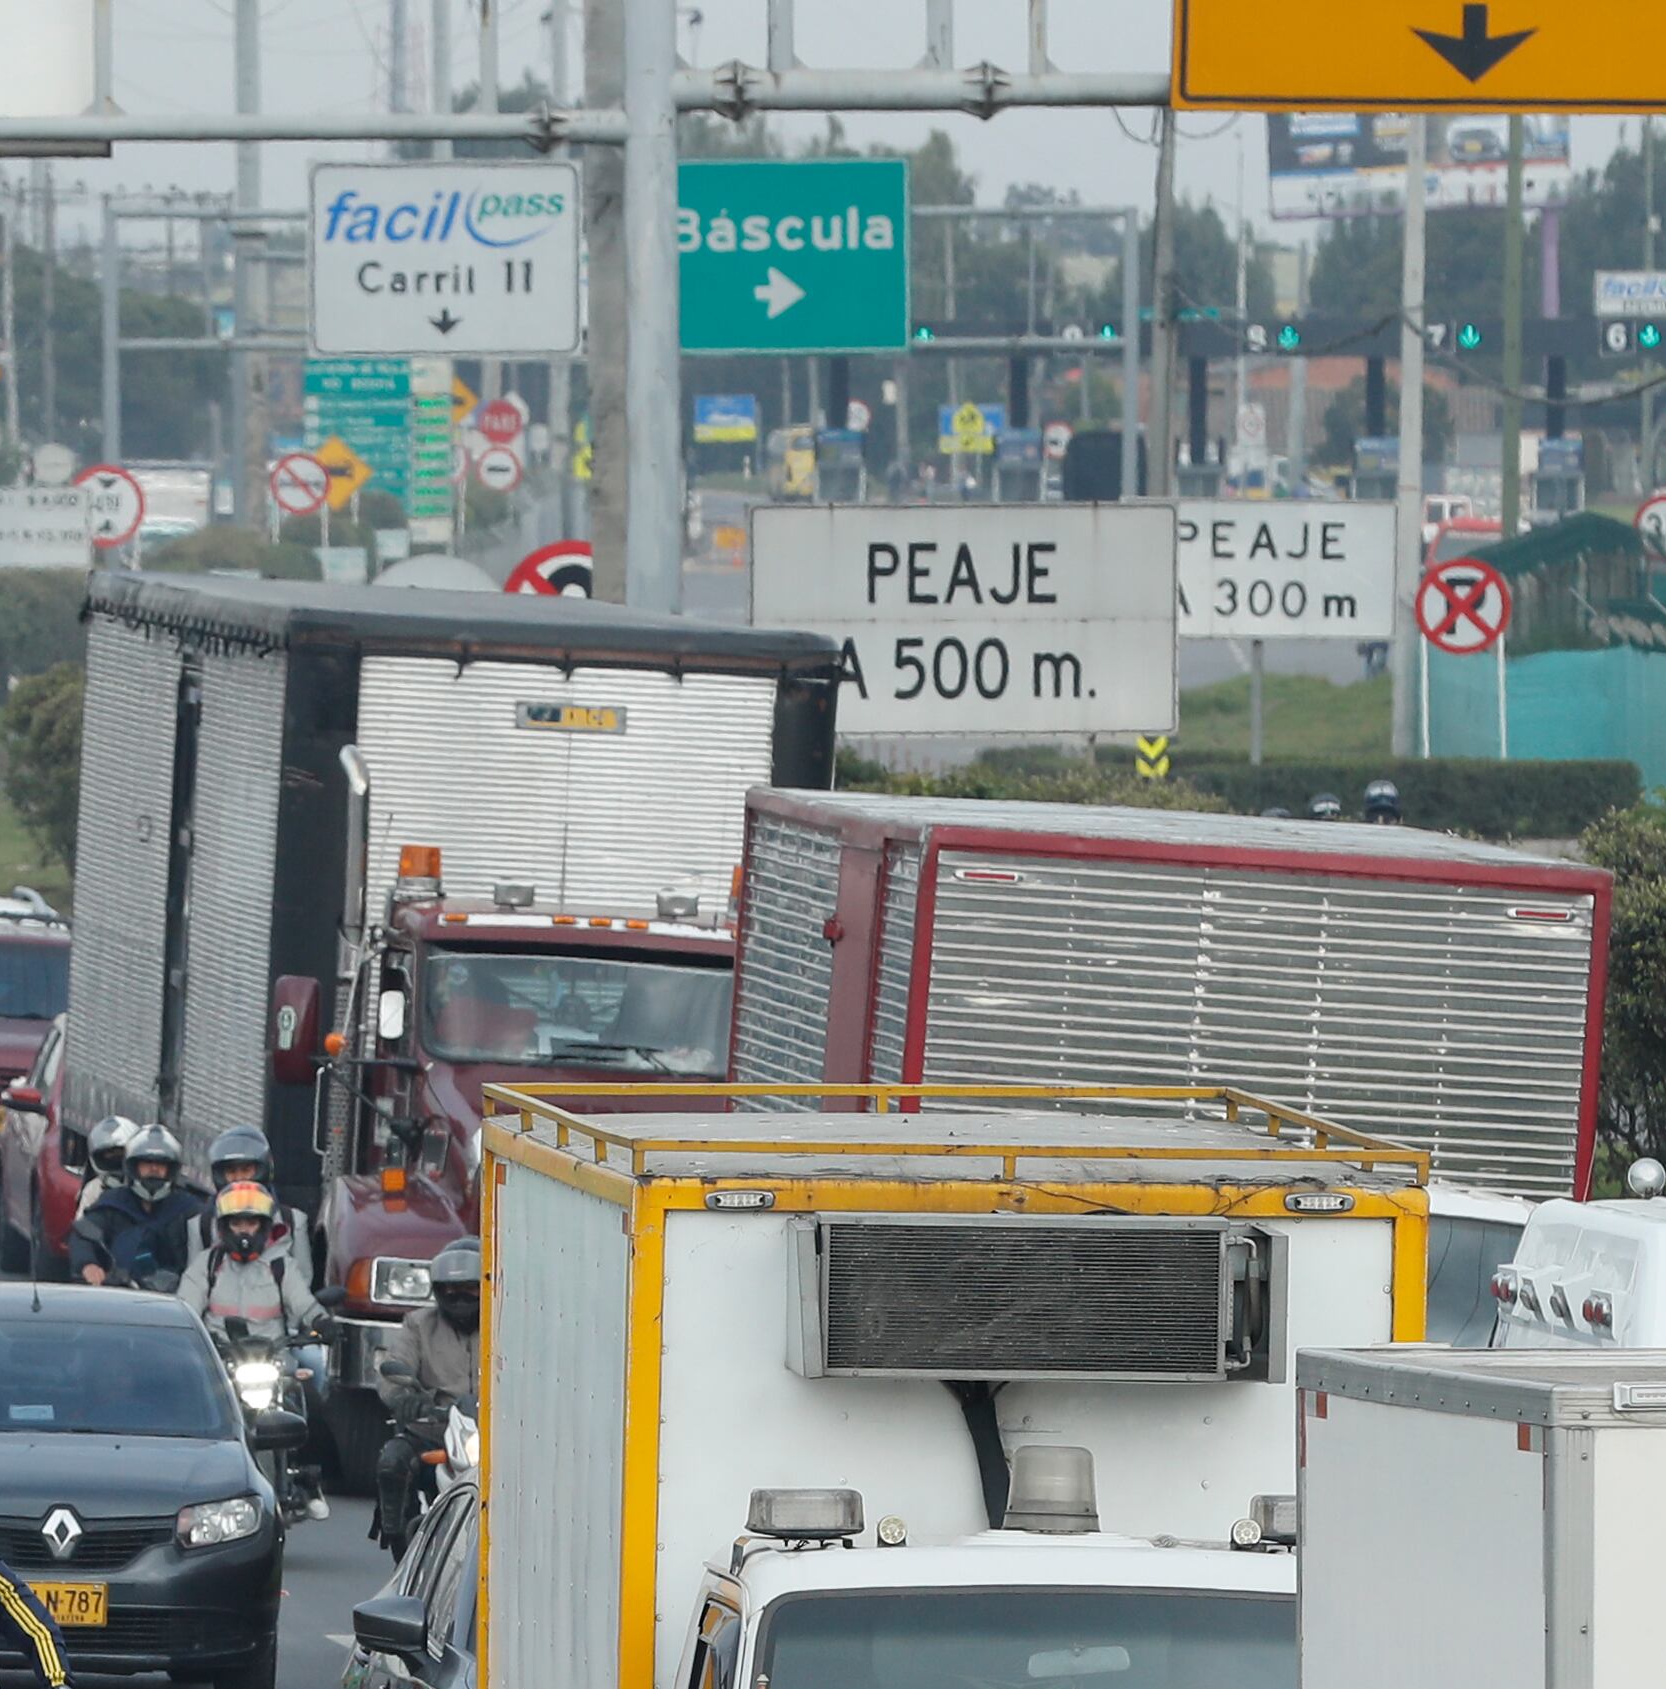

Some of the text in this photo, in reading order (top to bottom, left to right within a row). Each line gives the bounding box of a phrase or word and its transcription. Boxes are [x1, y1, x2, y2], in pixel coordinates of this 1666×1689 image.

[326, 191, 565, 242] facil pass
[358, 259, 533, 293] Carril 11
[1606, 322, 1628, 351] 6
[1180, 521, 1346, 561] PEAJE
[867, 542, 1058, 604] PEAJE
[1215, 579, 1307, 619] 300
[1323, 591, 1357, 619] m
[838, 636, 869, 700] A
[893, 636, 1010, 700] 500
